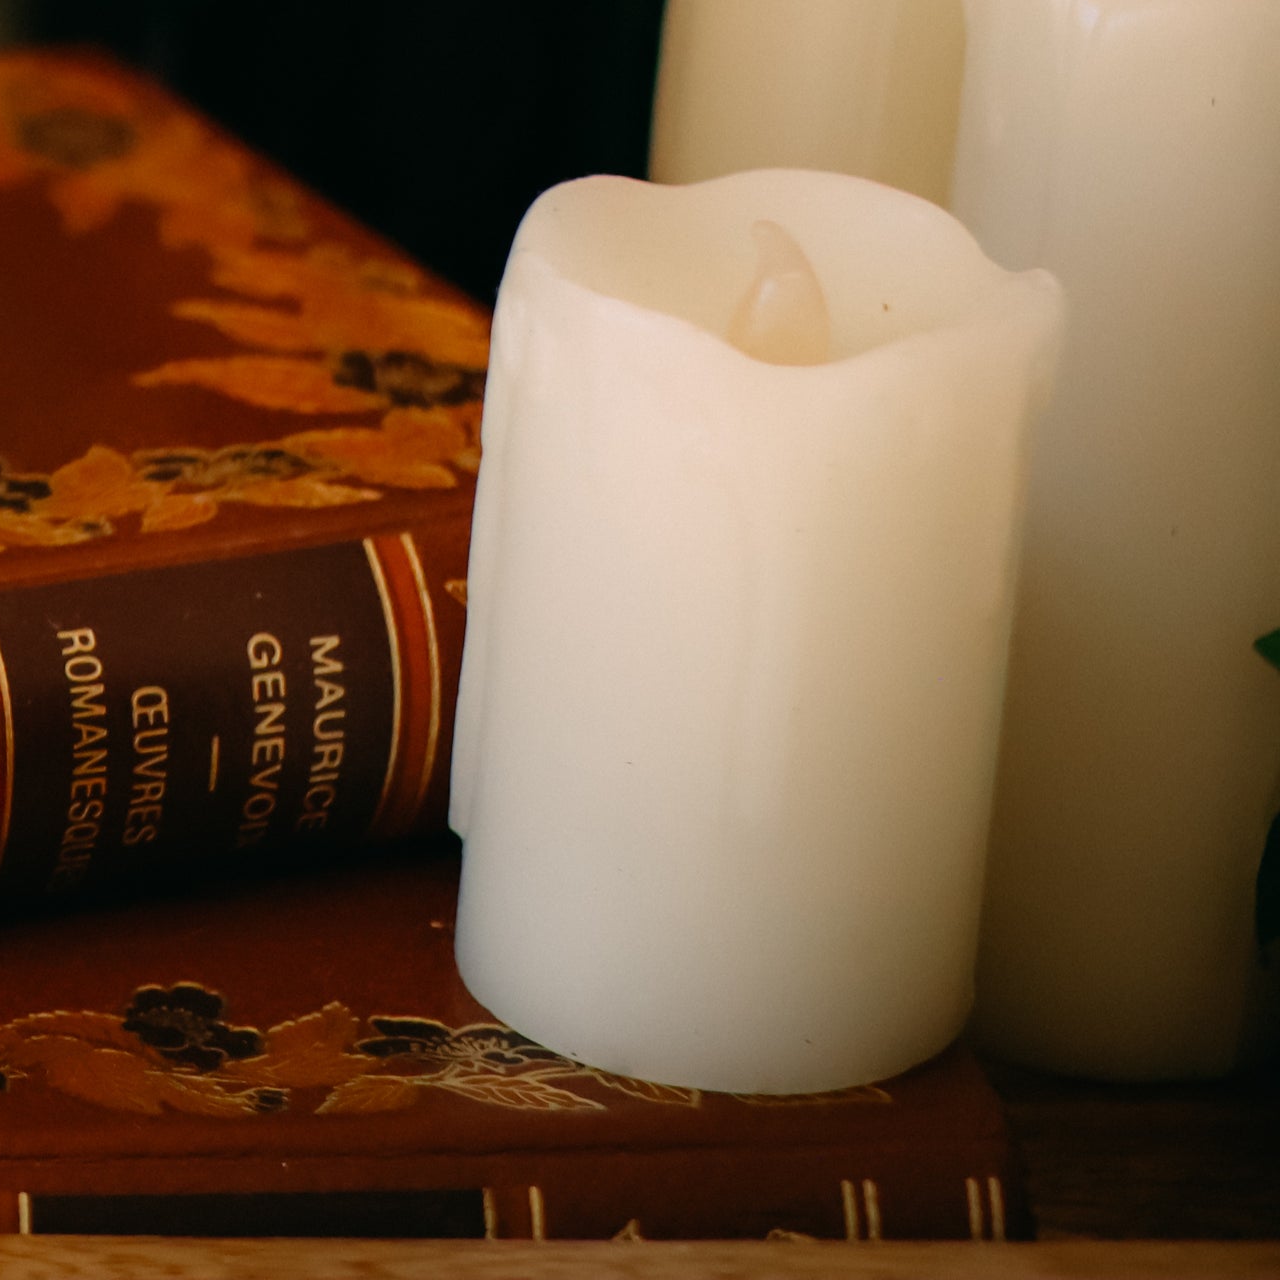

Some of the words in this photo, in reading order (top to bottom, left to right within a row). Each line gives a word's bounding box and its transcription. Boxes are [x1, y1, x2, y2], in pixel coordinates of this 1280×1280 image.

[45, 627, 109, 890] ROMANESQU
[121, 685, 169, 847] ŒUVRES
[294, 633, 346, 833] MAURICE
